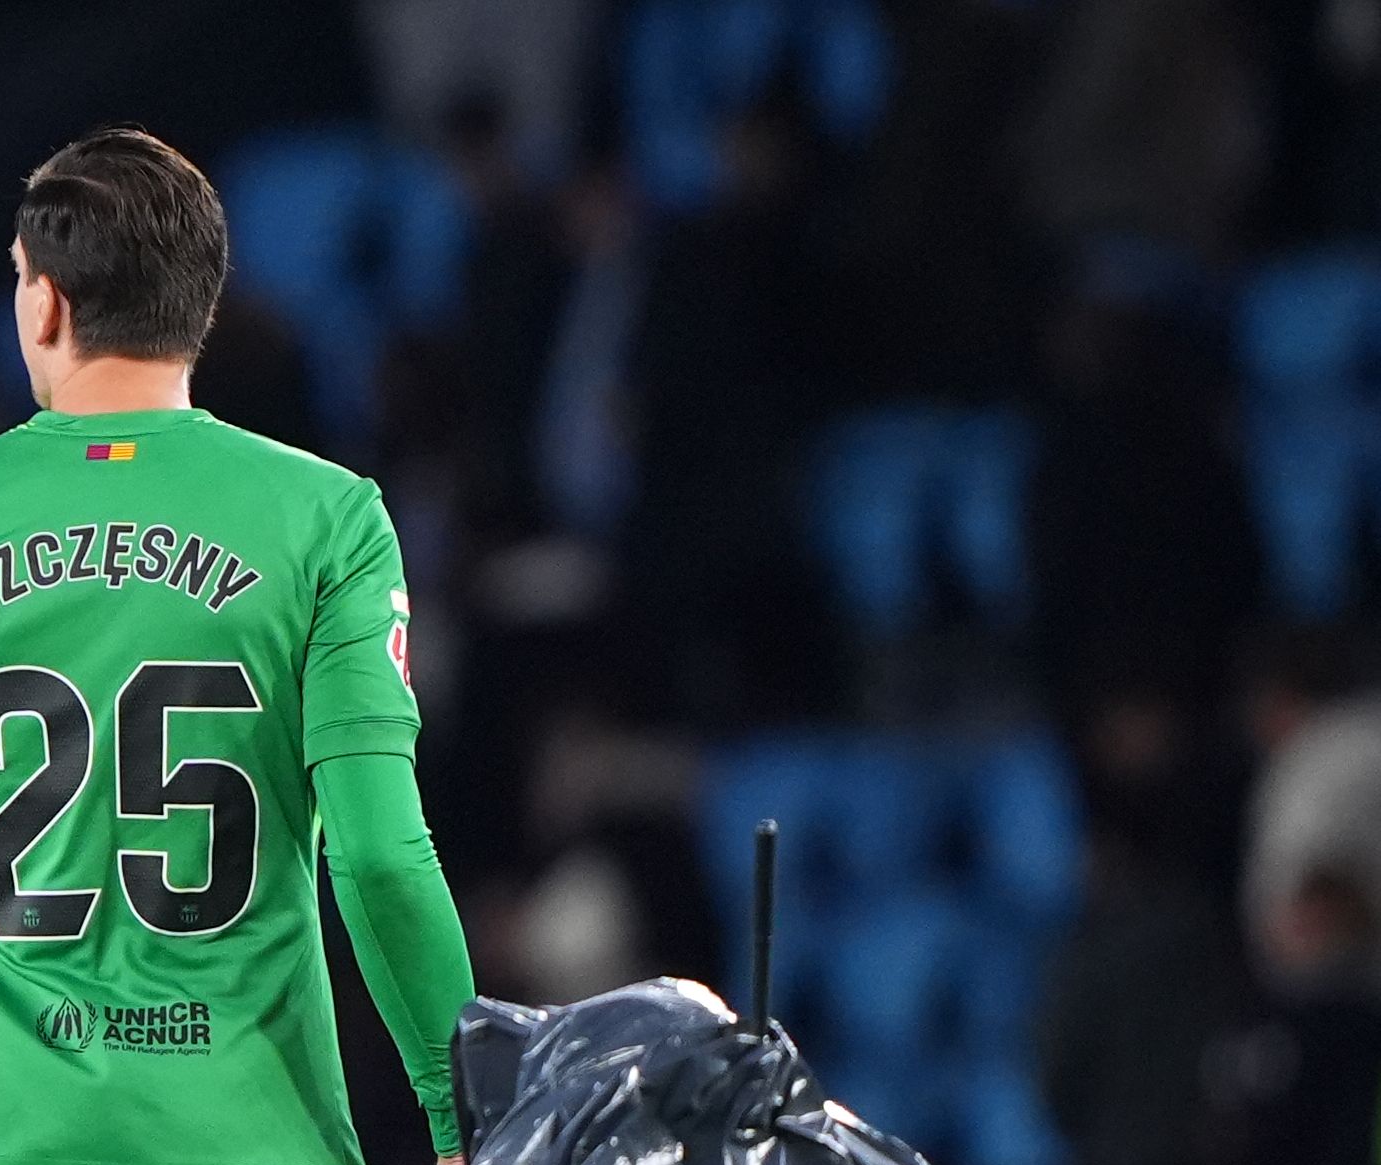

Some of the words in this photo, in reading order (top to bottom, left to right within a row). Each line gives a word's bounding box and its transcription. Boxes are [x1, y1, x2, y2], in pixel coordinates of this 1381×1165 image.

[104, 1002, 210, 1026] UNHCR
[103, 1023, 211, 1045] ACNUR
[103, 1043, 120, 1052] The
